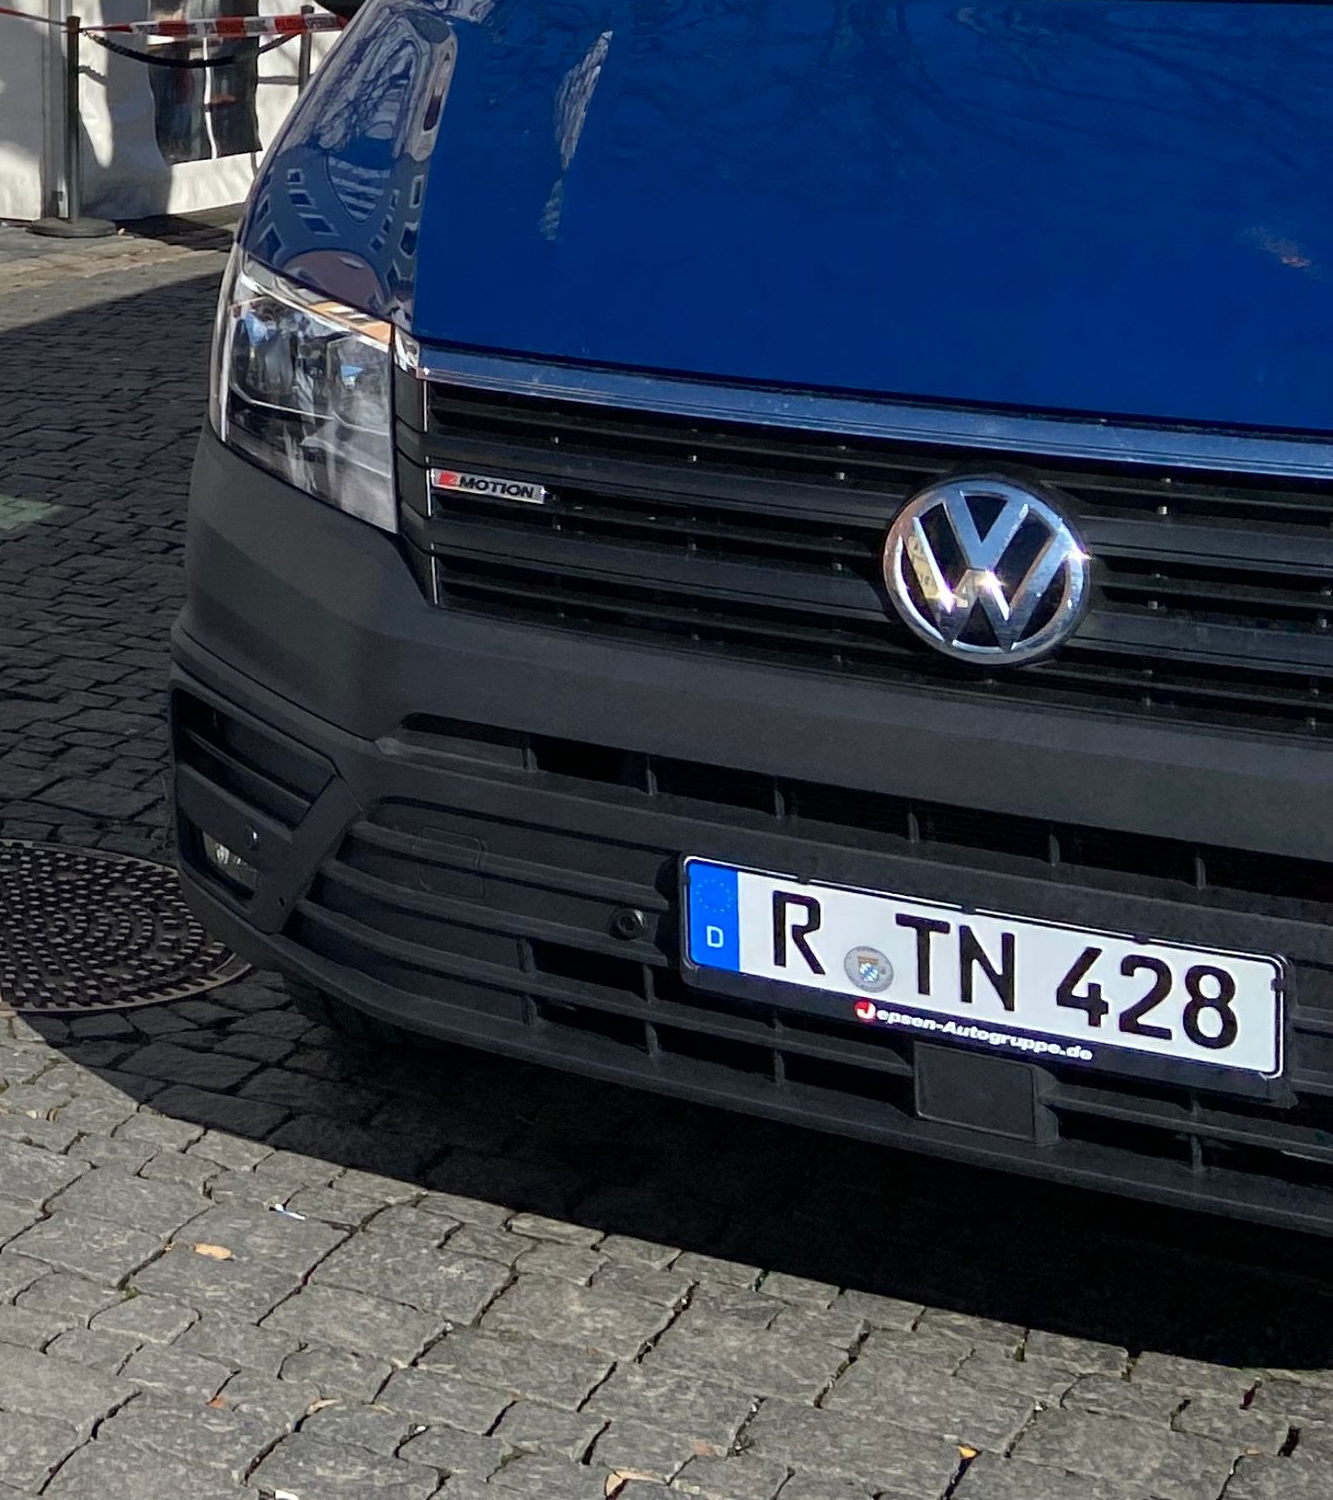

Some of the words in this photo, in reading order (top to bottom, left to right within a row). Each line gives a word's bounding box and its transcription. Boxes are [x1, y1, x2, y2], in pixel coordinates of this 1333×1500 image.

[705, 924, 724, 949] D
[771, 890, 827, 976] R
[895, 913, 1016, 1012] TN
[1055, 946, 1238, 1050] 428
